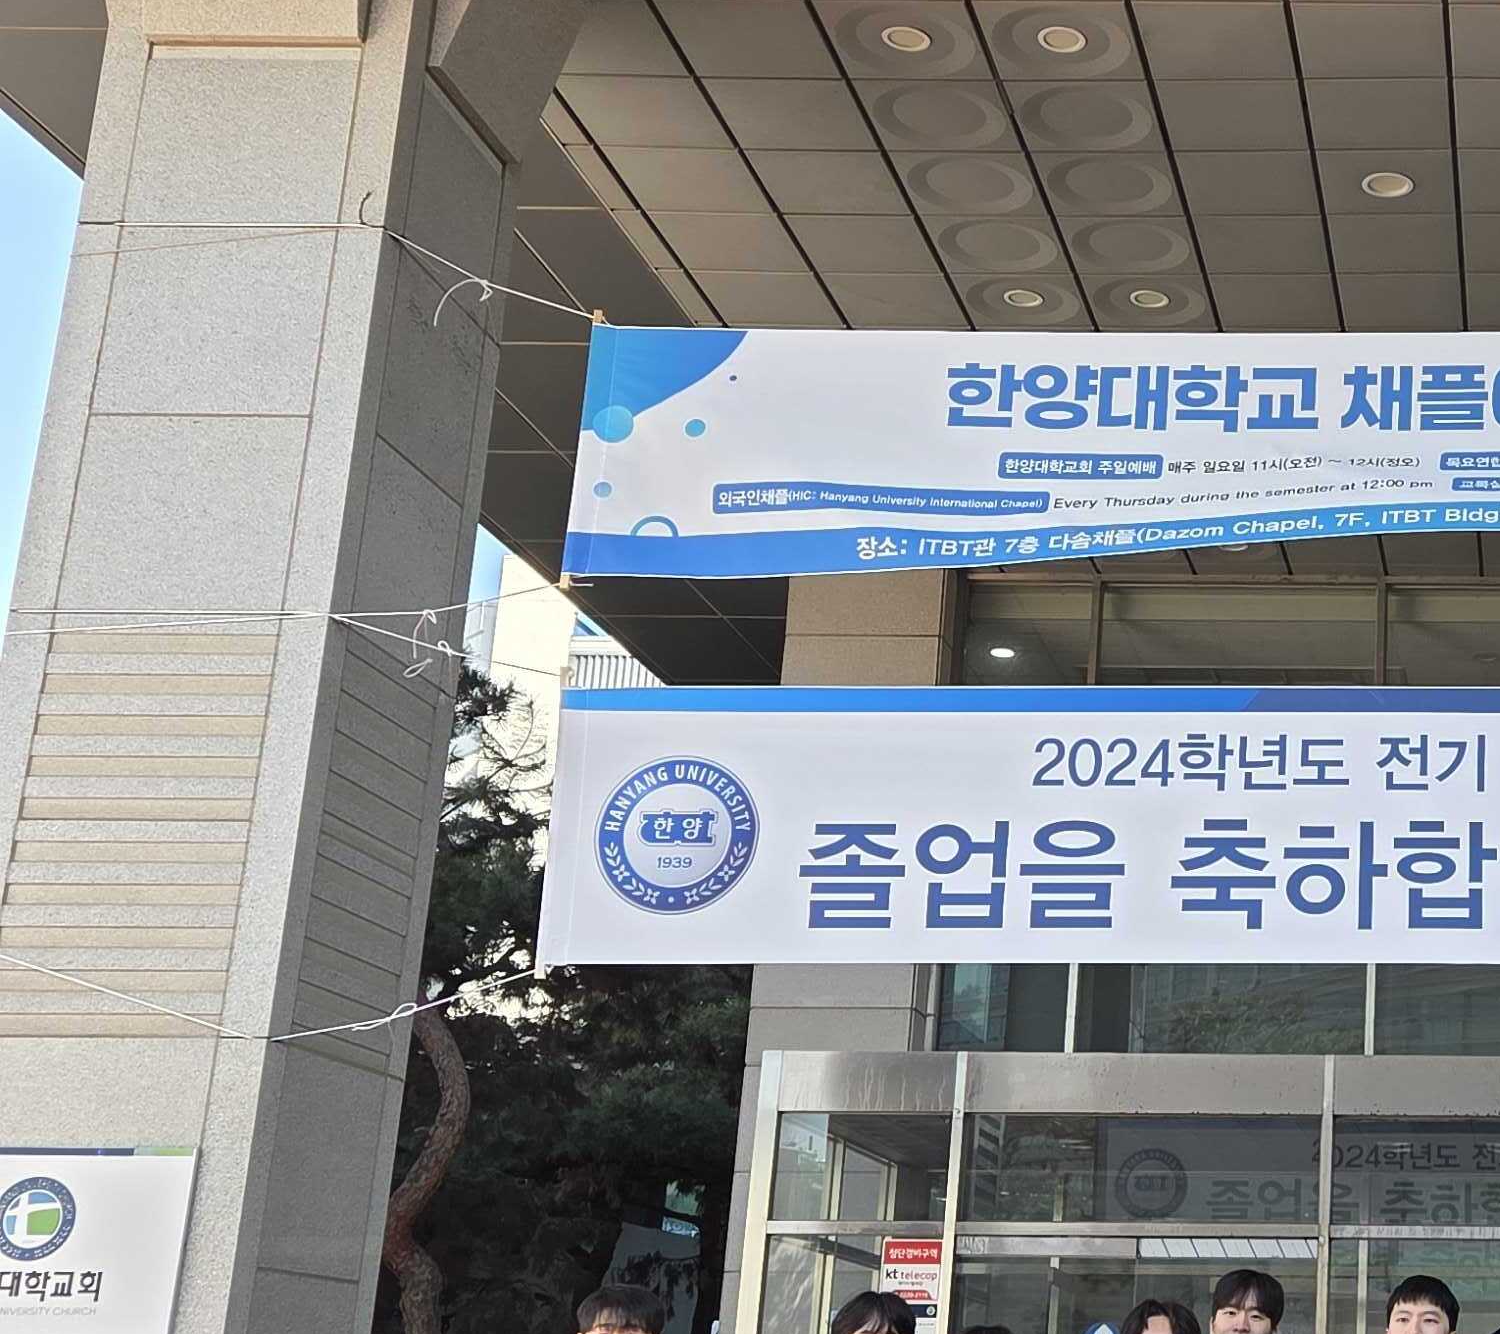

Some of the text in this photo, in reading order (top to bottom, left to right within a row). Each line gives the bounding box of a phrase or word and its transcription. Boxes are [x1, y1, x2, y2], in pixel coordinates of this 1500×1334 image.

[947, 362, 1319, 433] 한양대학교
[1004, 458, 1093, 475] 한양대학교회
[1097, 459, 1157, 475] 주일예배
[1168, 460, 1197, 474] 매주
[1203, 460, 1246, 474] 일요일
[1252, 455, 1323, 472] 11시(오전)
[1349, 456, 1421, 468] 12시(정오)
[718, 478, 1434, 510] 외국인채플(HIC: Hanyang University International Chapel) Every Thursday during the semester at 12:00 pm
[856, 535, 908, 560] 장소:
[918, 537, 997, 558] ITBT관
[1004, 536, 1041, 556] 7층
[1048, 525, 1224, 552] 다솜채플(Dazom
[1232, 514, 1325, 535] Chapel,
[1334, 512, 1371, 528] 7F,
[1381, 509, 1438, 525] ITBT
[1031, 733, 1486, 793] 2024학년도 전기
[604, 764, 752, 832] HANYANG UNIVERSITY
[653, 817, 704, 840] 한양
[657, 856, 692, 869] 1939
[799, 819, 1126, 929] 졸업을
[0, 1270, 103, 1303] 대학교회
[885, 1268, 938, 1281] kt telecop
